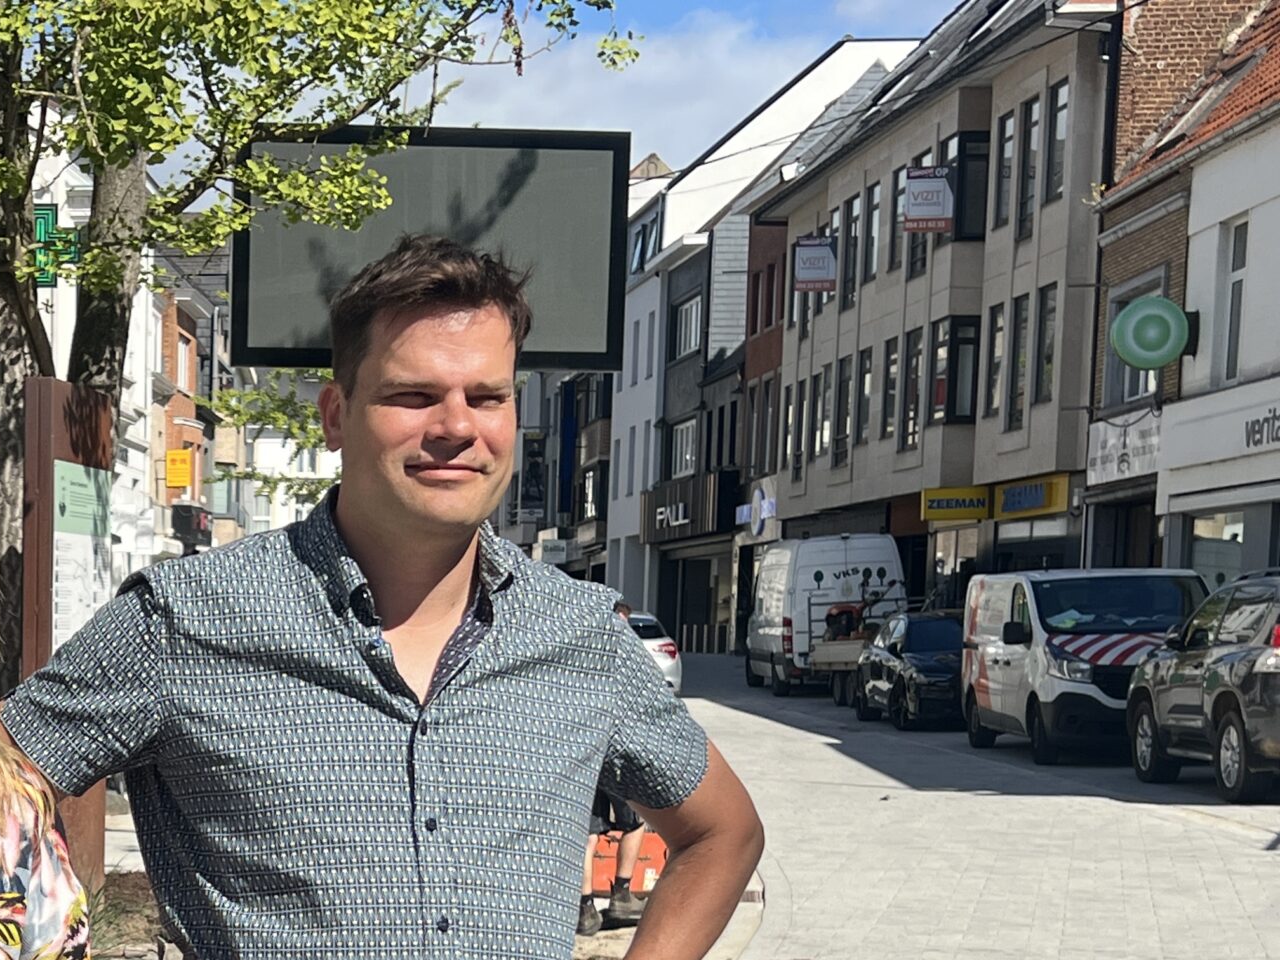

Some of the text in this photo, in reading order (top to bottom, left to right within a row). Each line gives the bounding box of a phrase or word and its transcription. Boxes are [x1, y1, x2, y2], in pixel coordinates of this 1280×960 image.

[911, 190, 942, 202] VIZIT
[927, 498, 986, 509] ZEEMAN
[833, 566, 860, 580] VKS
